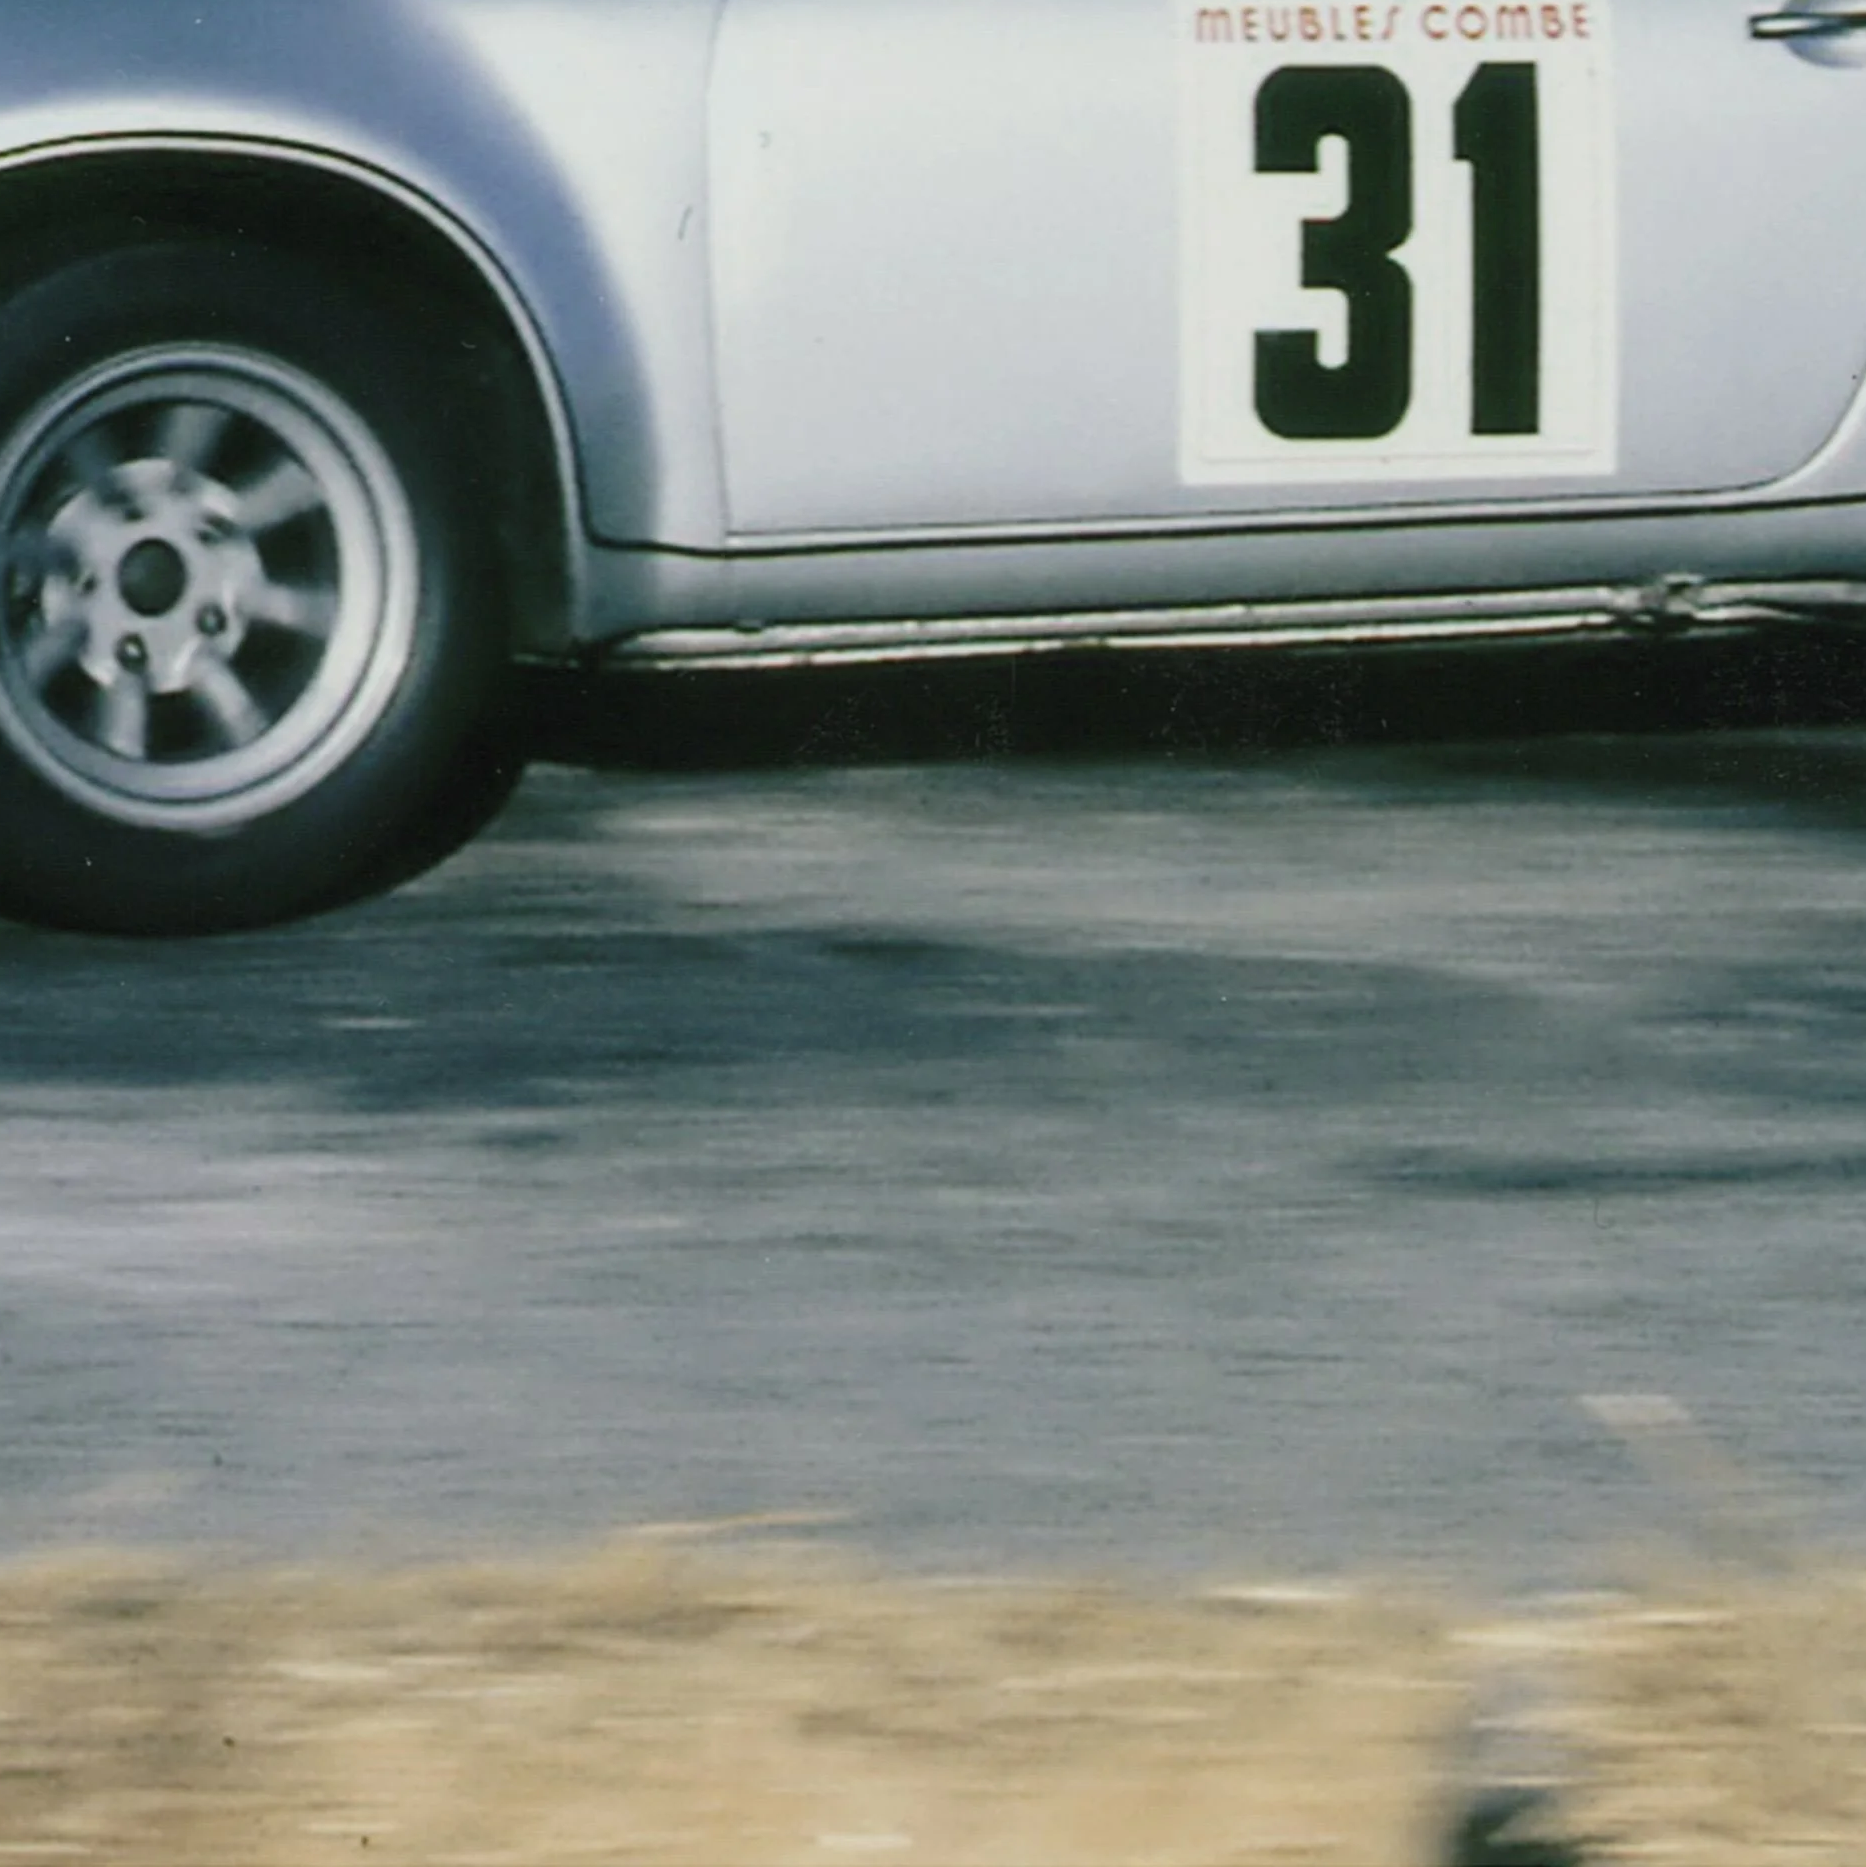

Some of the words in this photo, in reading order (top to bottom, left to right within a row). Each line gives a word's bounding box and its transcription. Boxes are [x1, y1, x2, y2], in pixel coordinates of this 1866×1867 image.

[1194, 4, 1402, 44] MEUBLES
[1419, 1, 1591, 41] COMBE
[1252, 60, 1542, 441] 31
